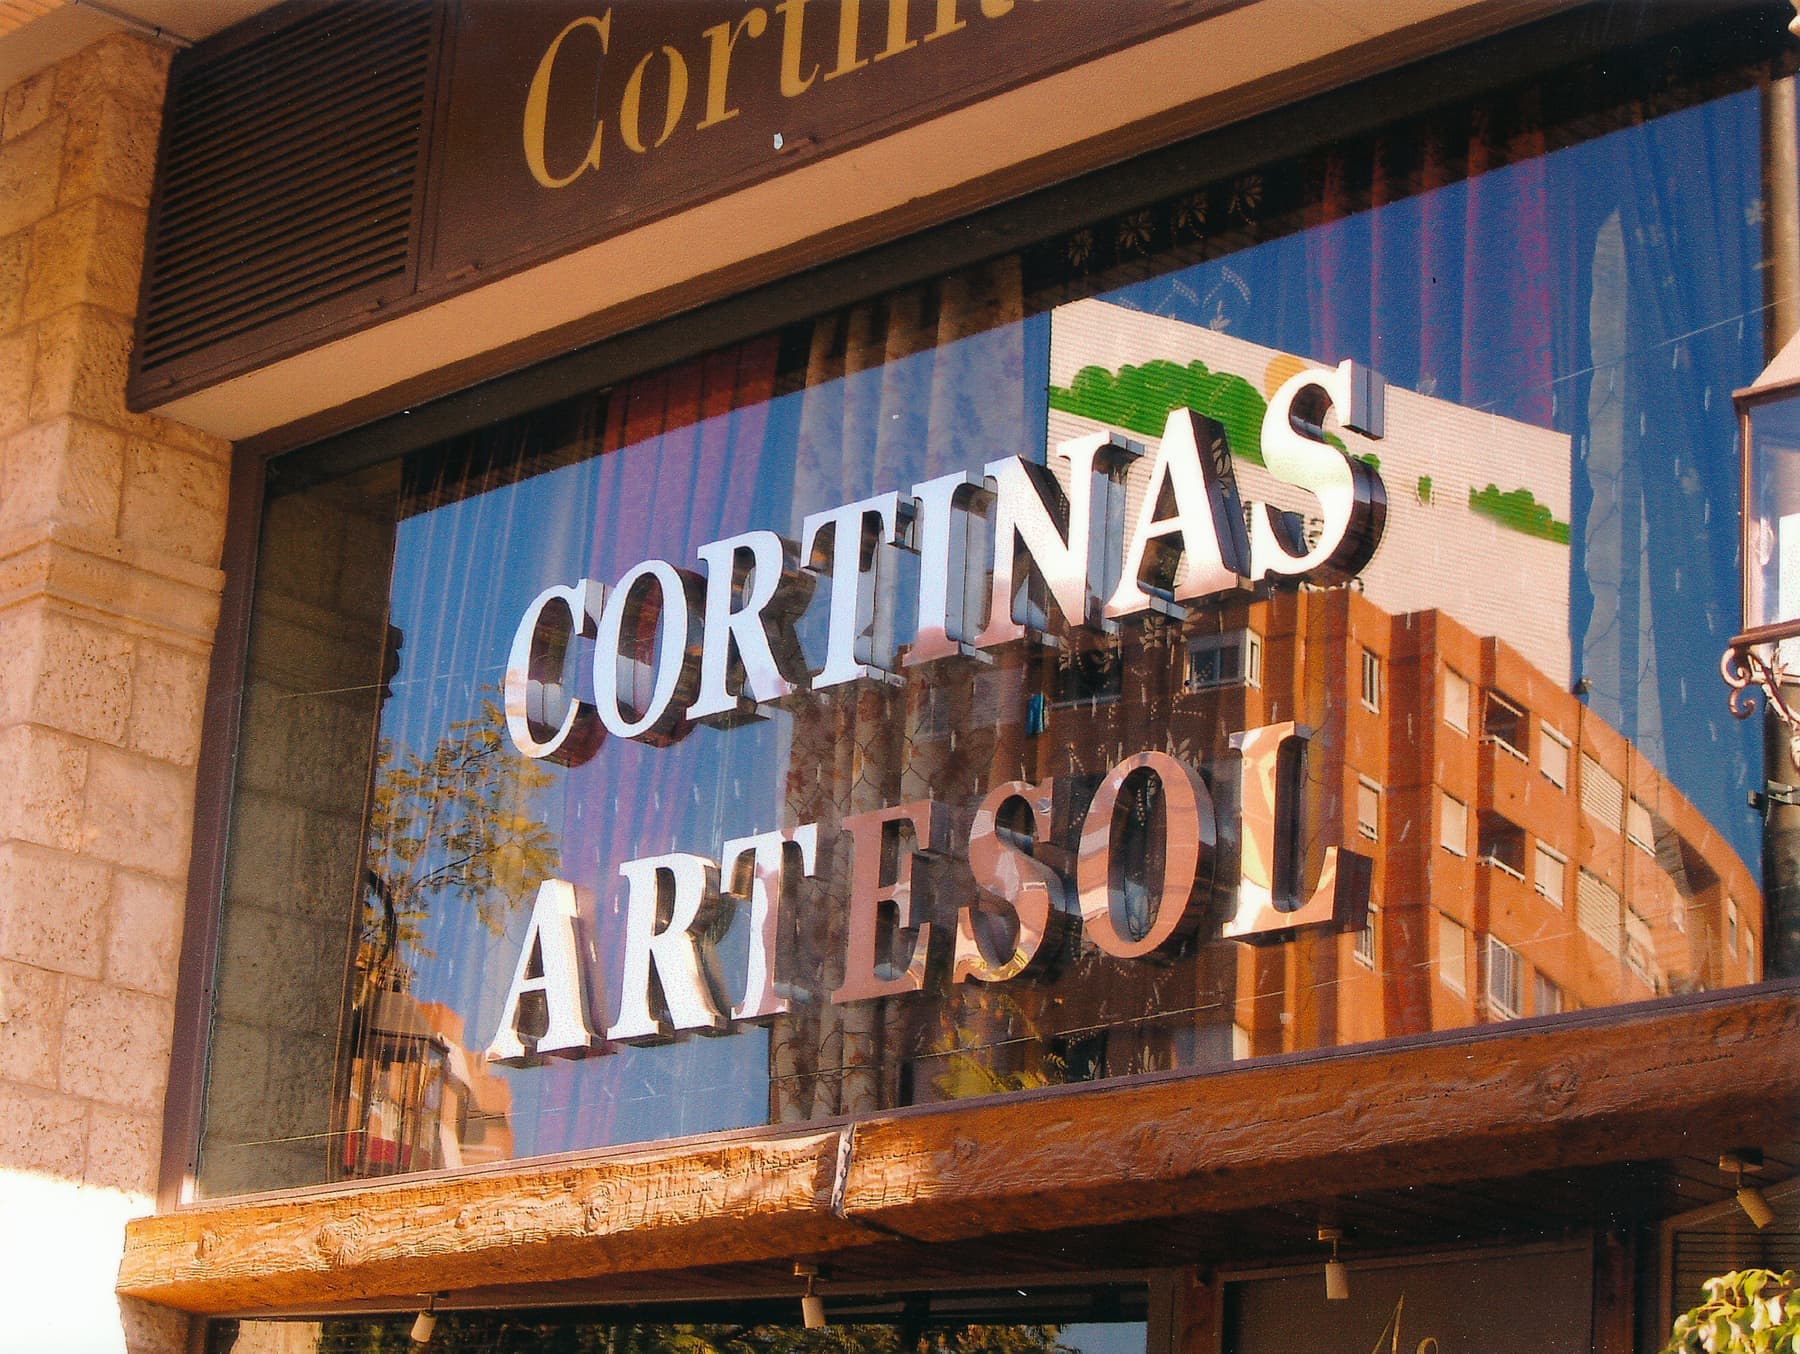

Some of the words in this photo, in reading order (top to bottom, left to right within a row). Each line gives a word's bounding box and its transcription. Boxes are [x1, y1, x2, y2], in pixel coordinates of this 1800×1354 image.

[522, 0, 1014, 188] Cortin
[504, 359, 1386, 766] CORTINAS
[486, 721, 1371, 1062] ARTESOL
